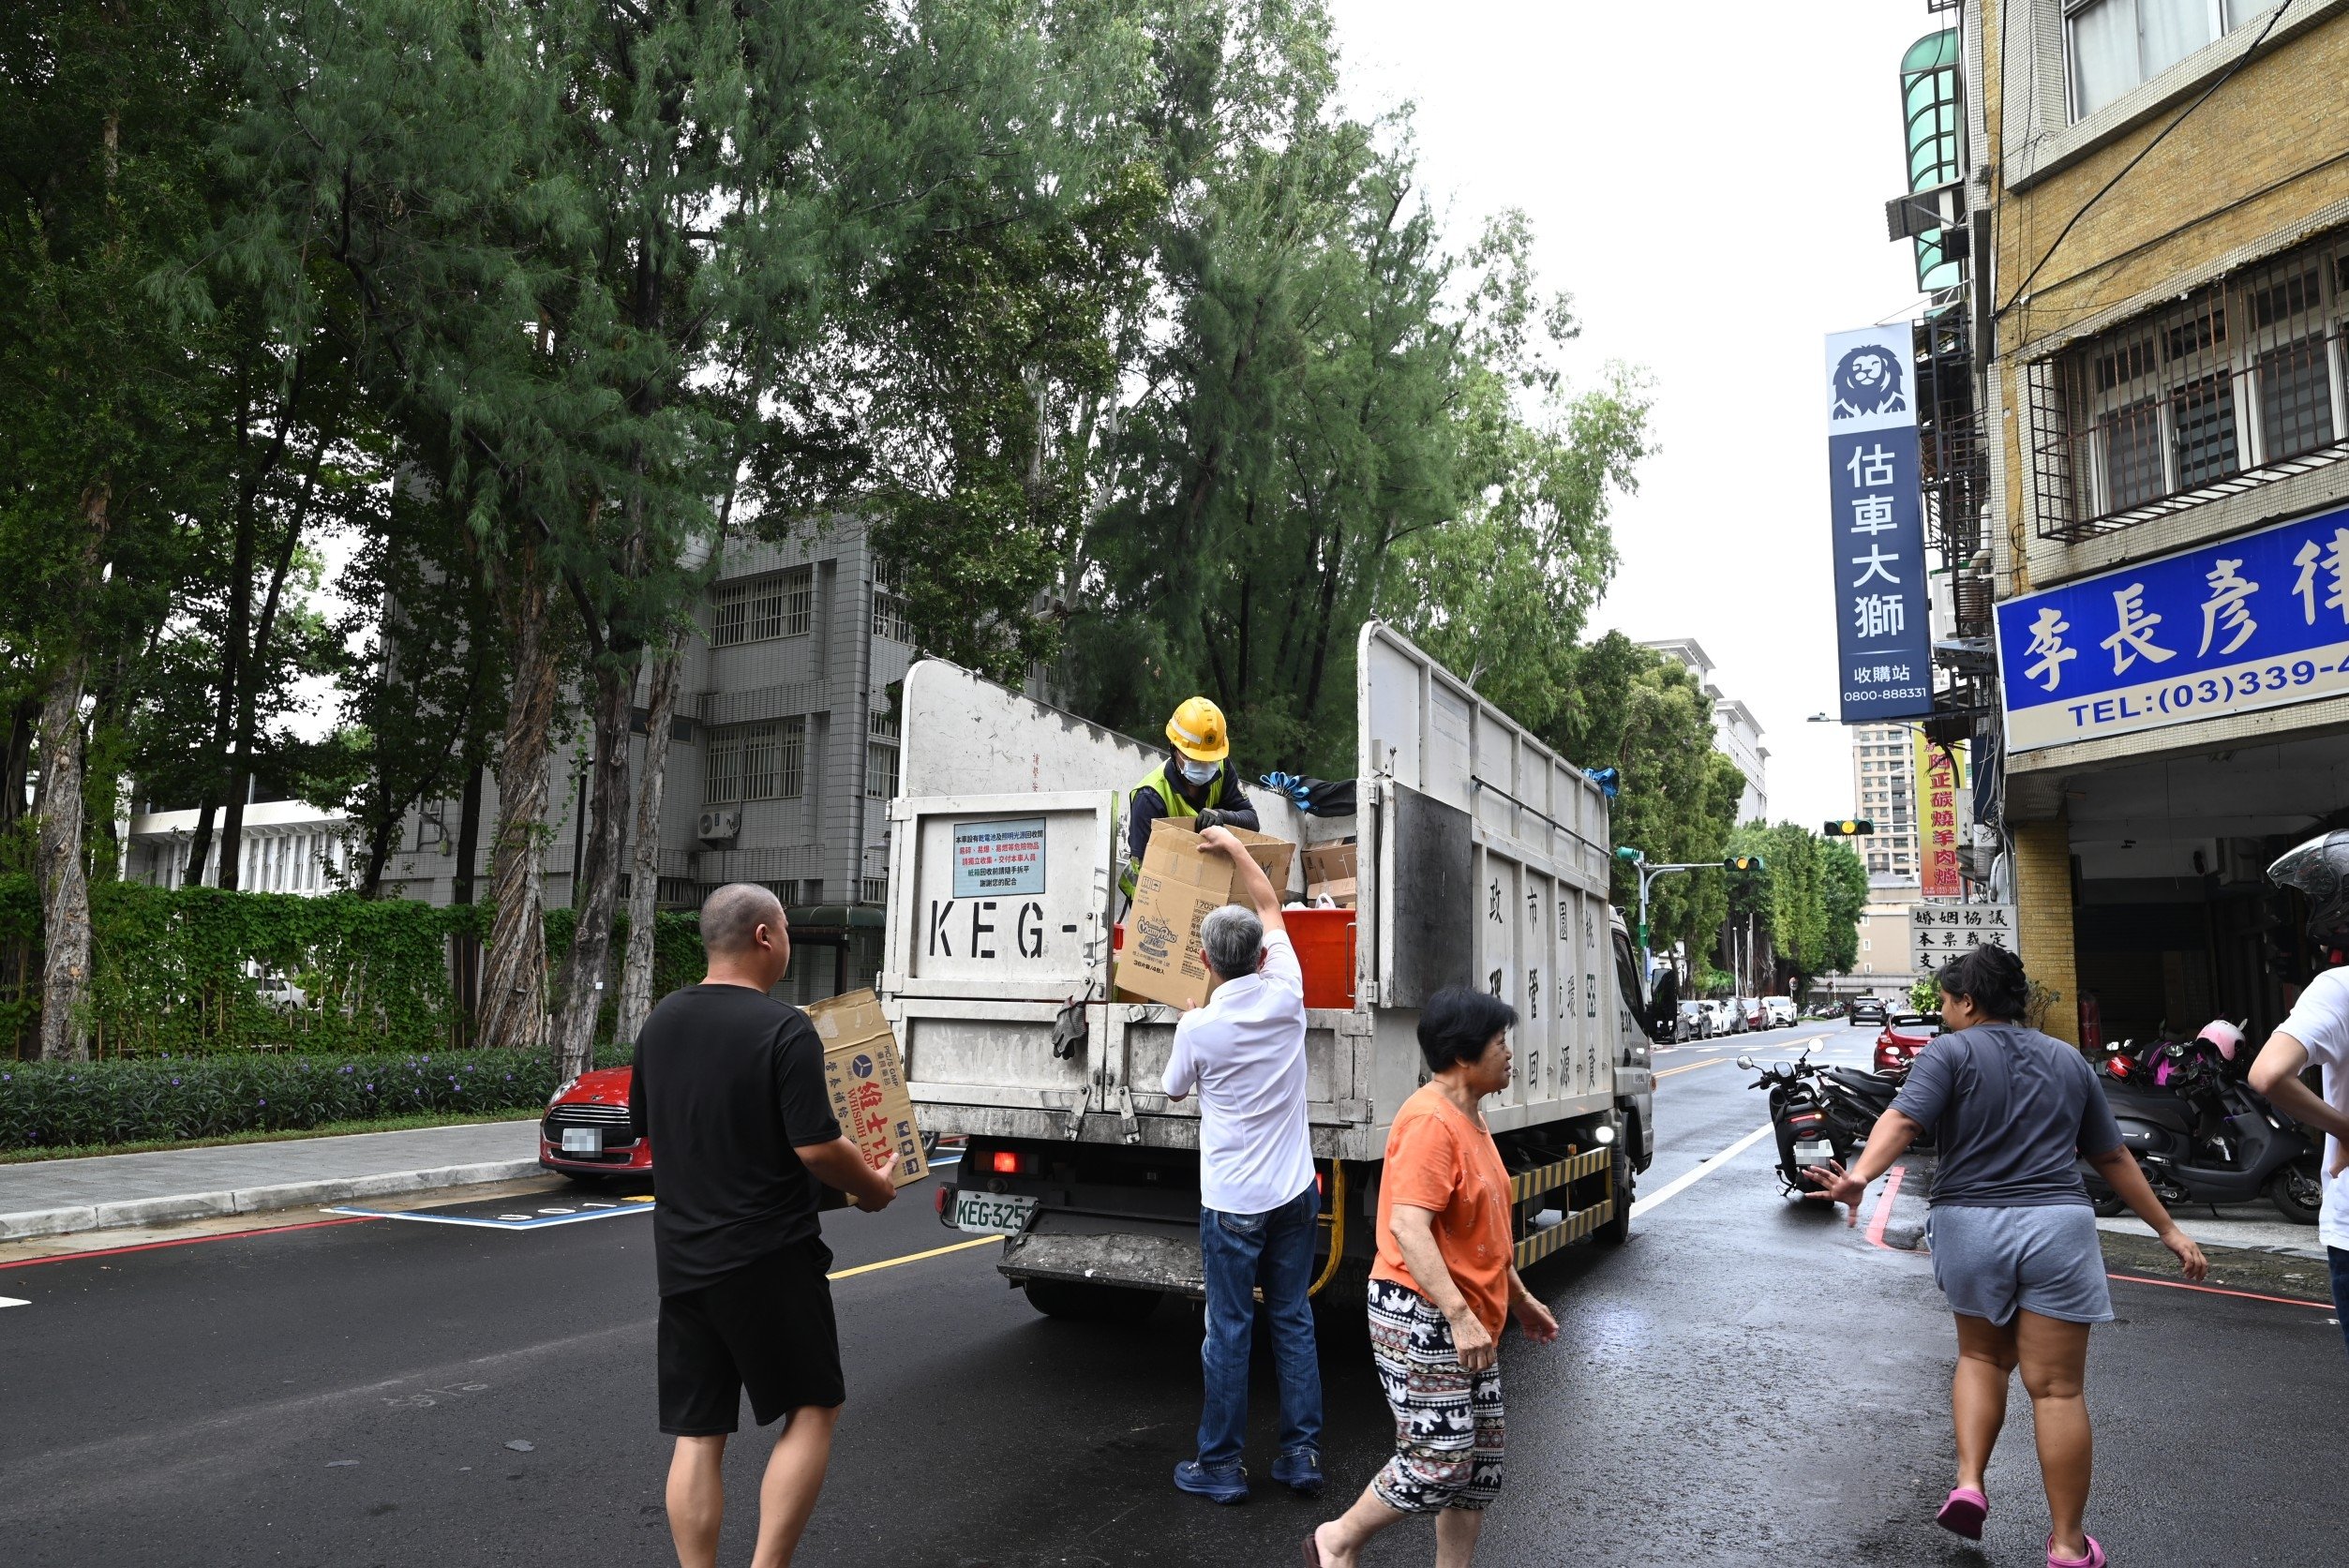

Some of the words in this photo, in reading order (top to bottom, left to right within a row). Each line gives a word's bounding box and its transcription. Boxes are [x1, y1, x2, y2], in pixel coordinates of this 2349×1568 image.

[1847, 443, 1905, 638] 估車大獅
[1853, 664, 1910, 684] 收購站
[1844, 687, 1927, 702] 0800-888331
[980, 877, 1017, 888] 謝謝您的配合
[1914, 909, 2008, 927] 婚姻協議
[1137, 916, 1178, 944] MamyPoko
[1918, 931, 2008, 948] 本票裁定
[1620, 1010, 1633, 1033] 238
[857, 1081, 894, 1171] 維士比
